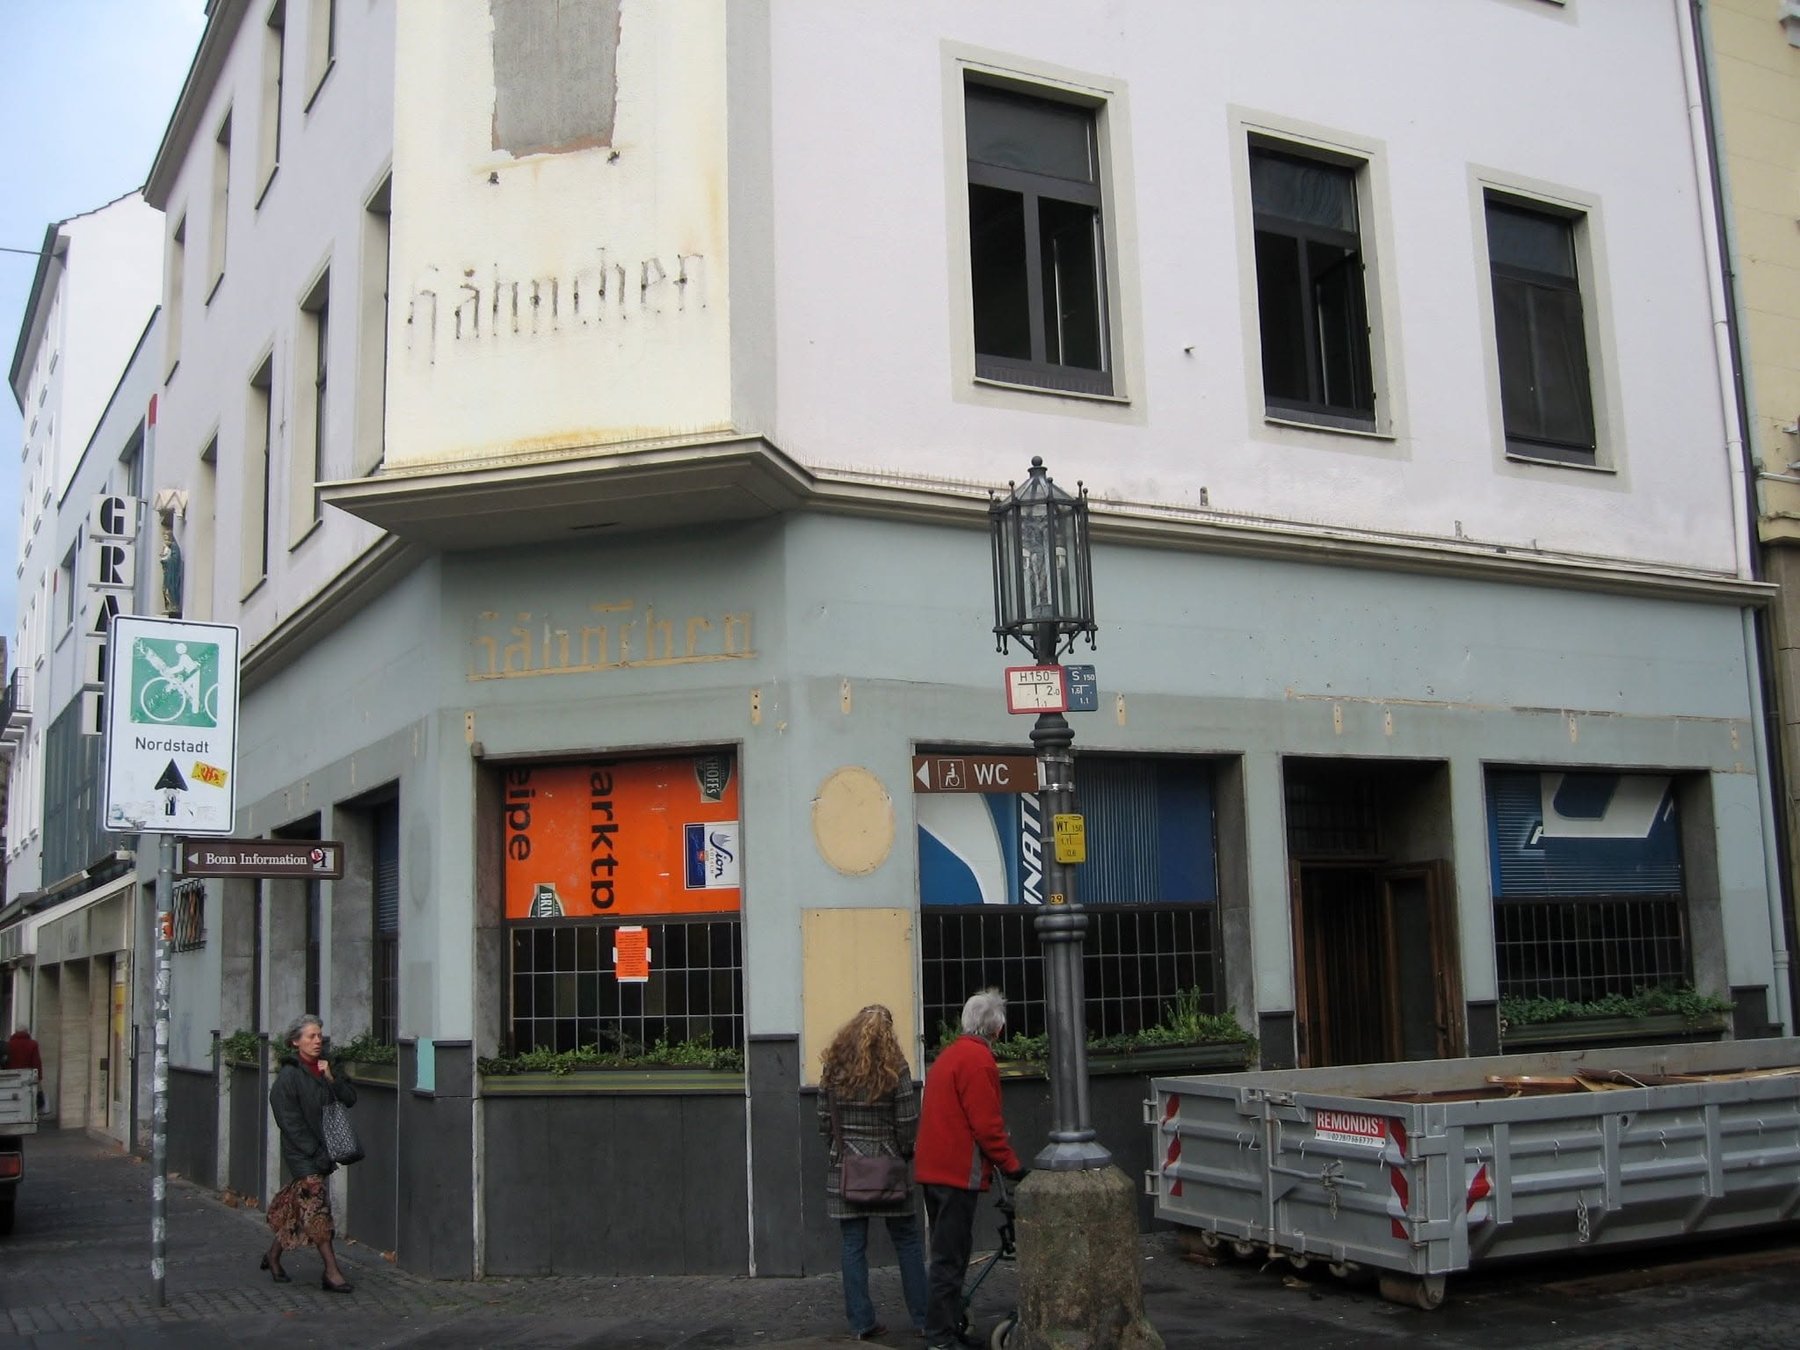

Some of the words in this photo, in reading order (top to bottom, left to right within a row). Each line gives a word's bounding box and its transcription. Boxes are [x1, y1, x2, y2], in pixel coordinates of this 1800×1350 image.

[1083, 673, 1095, 682] 150
[135, 736, 210, 754] Nordstadt
[973, 763, 1010, 785] WC
[590, 762, 620, 917] arktp
[205, 852, 236, 865] Bonn
[239, 852, 308, 865] Information
[709, 831, 733, 880] Sion
[1317, 1111, 1379, 1135] REMONDIS
